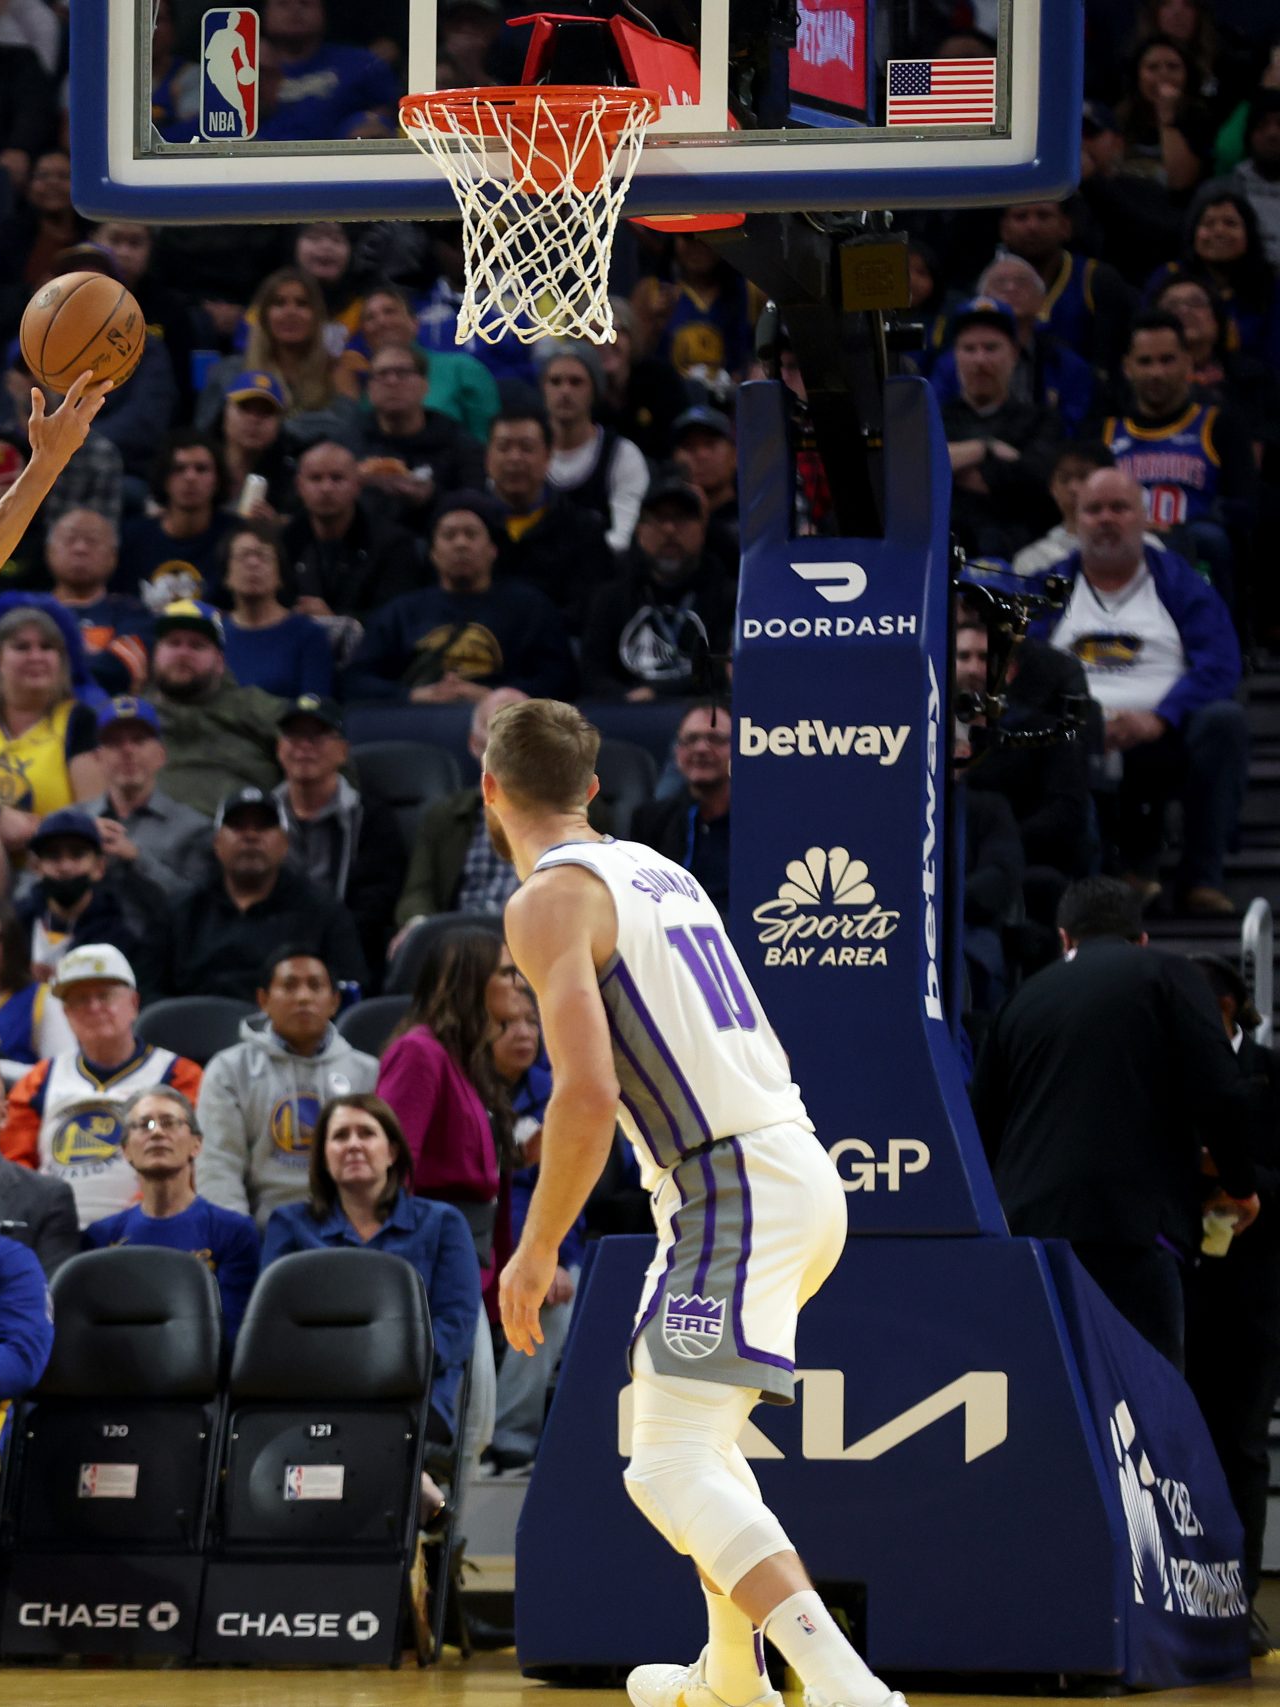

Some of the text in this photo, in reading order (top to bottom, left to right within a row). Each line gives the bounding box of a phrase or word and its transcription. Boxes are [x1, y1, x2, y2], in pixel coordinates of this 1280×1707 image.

[209, 111, 236, 132] NBA
[742, 614, 917, 640] DOORDASH
[739, 717, 911, 767] betway
[922, 656, 944, 1021] betway
[752, 897, 901, 950] Sports
[764, 945, 888, 966] BAY AREA
[665, 924, 757, 1032] 10
[665, 1316, 722, 1337] SAC
[102, 1424, 129, 1437] 120
[310, 1423, 332, 1437] 121
[18, 1602, 142, 1628] CHASE
[216, 1612, 342, 1638] CHASE
